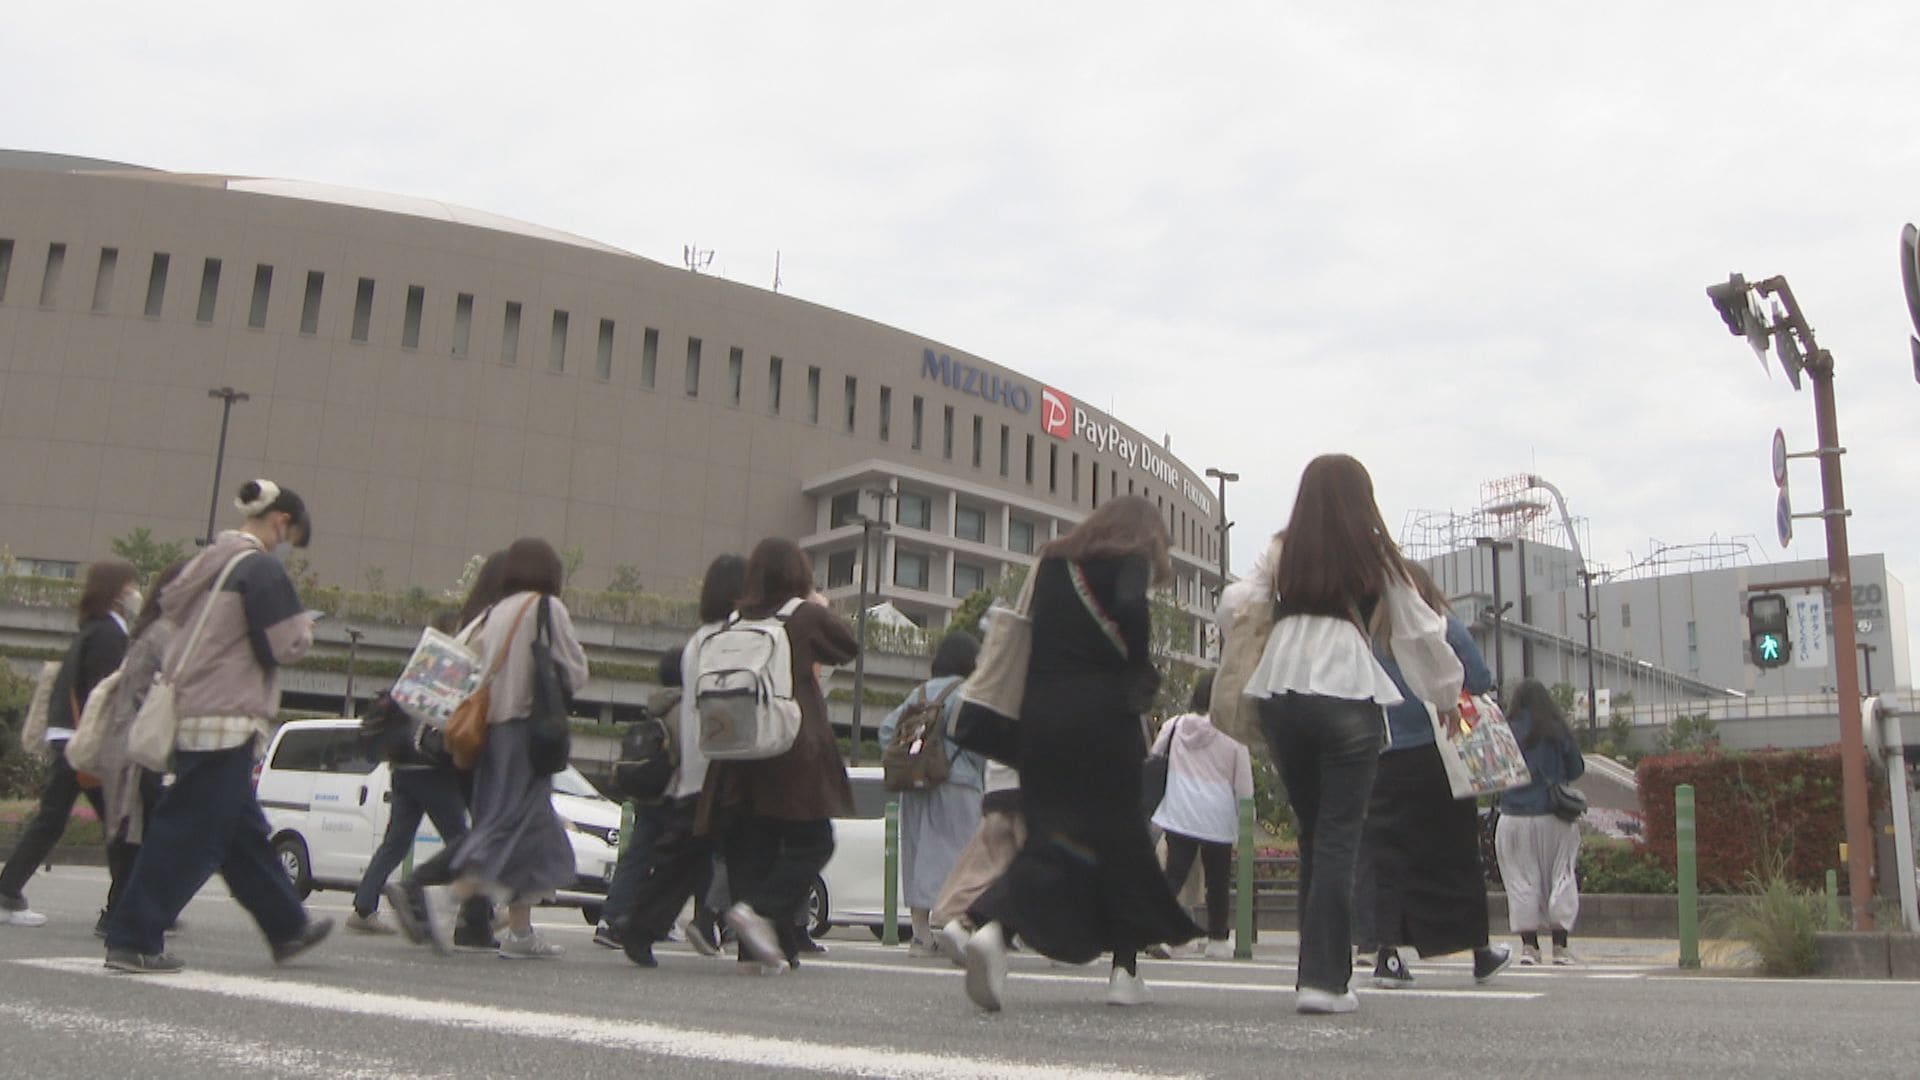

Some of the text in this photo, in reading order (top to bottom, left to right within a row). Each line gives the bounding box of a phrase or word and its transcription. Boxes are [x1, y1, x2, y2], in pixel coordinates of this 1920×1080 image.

[923, 348, 1032, 414] MIZUHO
[1073, 406, 1137, 468] PayPay
[1142, 443, 1179, 490] Dome
